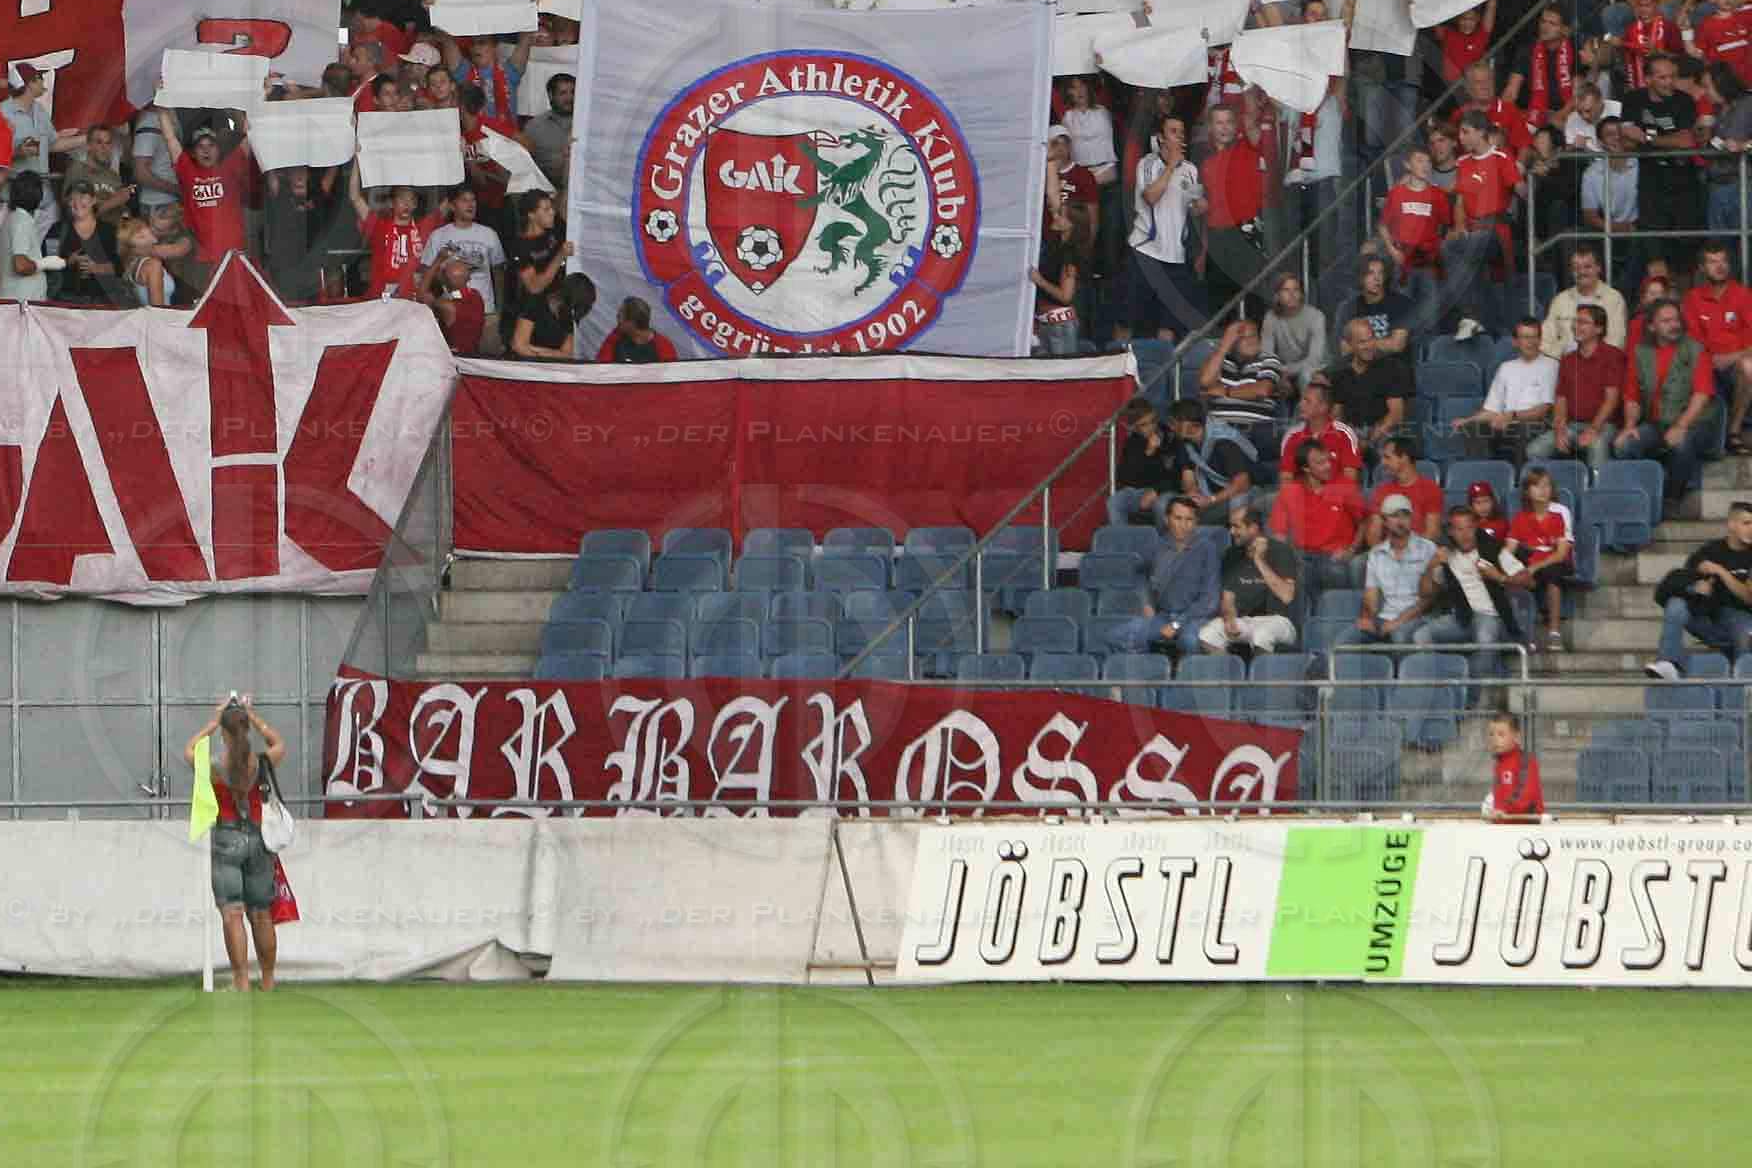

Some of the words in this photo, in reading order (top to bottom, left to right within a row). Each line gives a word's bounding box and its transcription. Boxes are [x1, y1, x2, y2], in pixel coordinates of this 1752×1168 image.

[650, 81, 745, 201] Grazer
[756, 62, 913, 121] Athletik
[913, 119, 966, 220] Klub
[853, 299, 927, 353] 1902
[914, 839, 1240, 967] JÖBSTL
[1365, 831, 1411, 974] UMZÜGE
